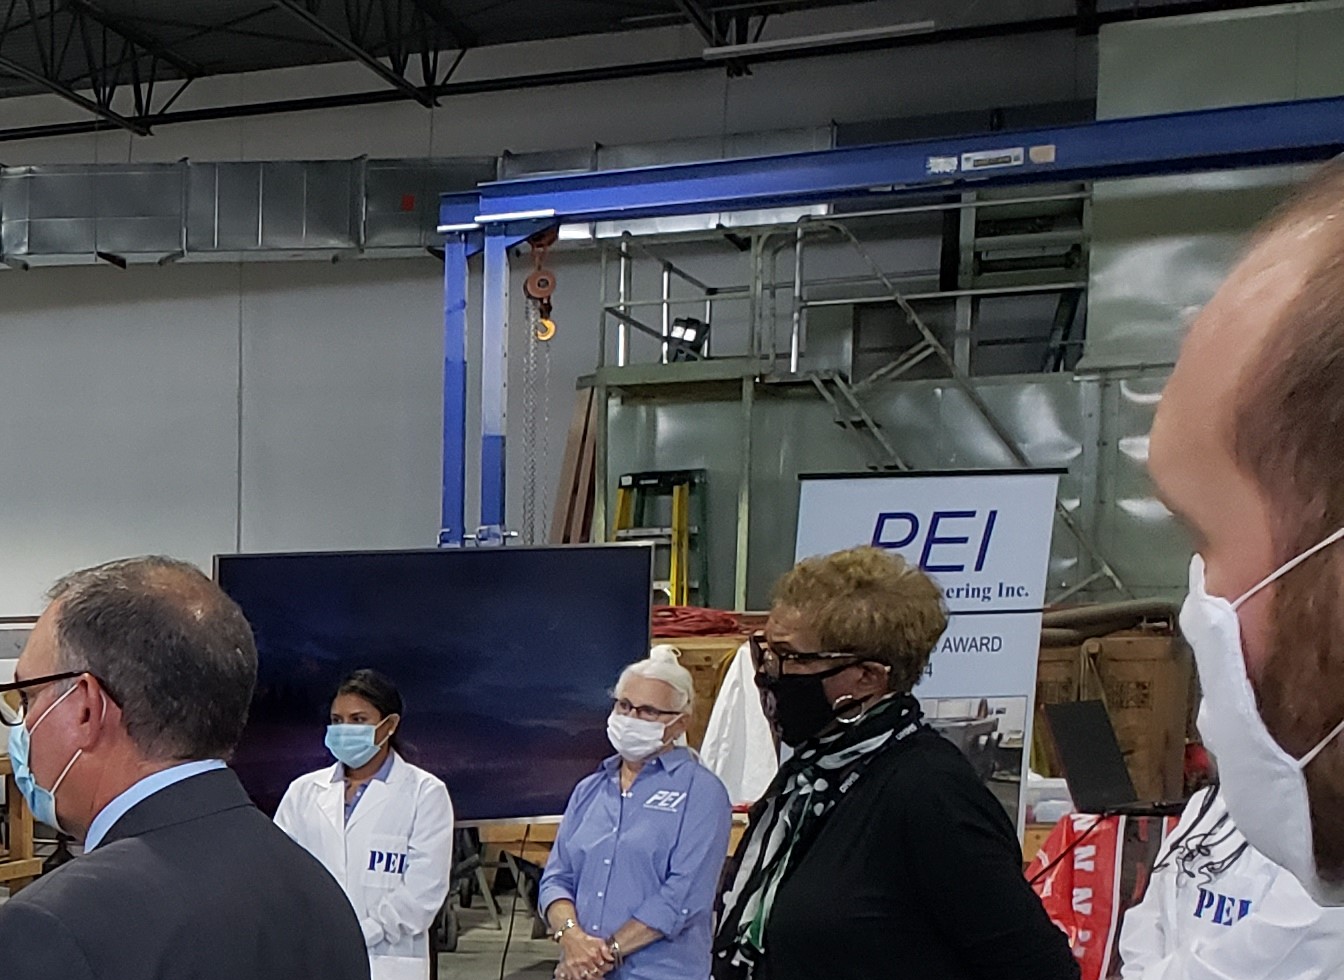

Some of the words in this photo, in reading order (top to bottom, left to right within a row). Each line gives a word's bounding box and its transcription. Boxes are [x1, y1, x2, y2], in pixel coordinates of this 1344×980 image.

[998, 582, 1029, 598] Inc.
[941, 636, 1003, 653] AWARD
[645, 790, 687, 807] PEI
[367, 850, 407, 873] PEI
[1193, 887, 1252, 926] PEI
